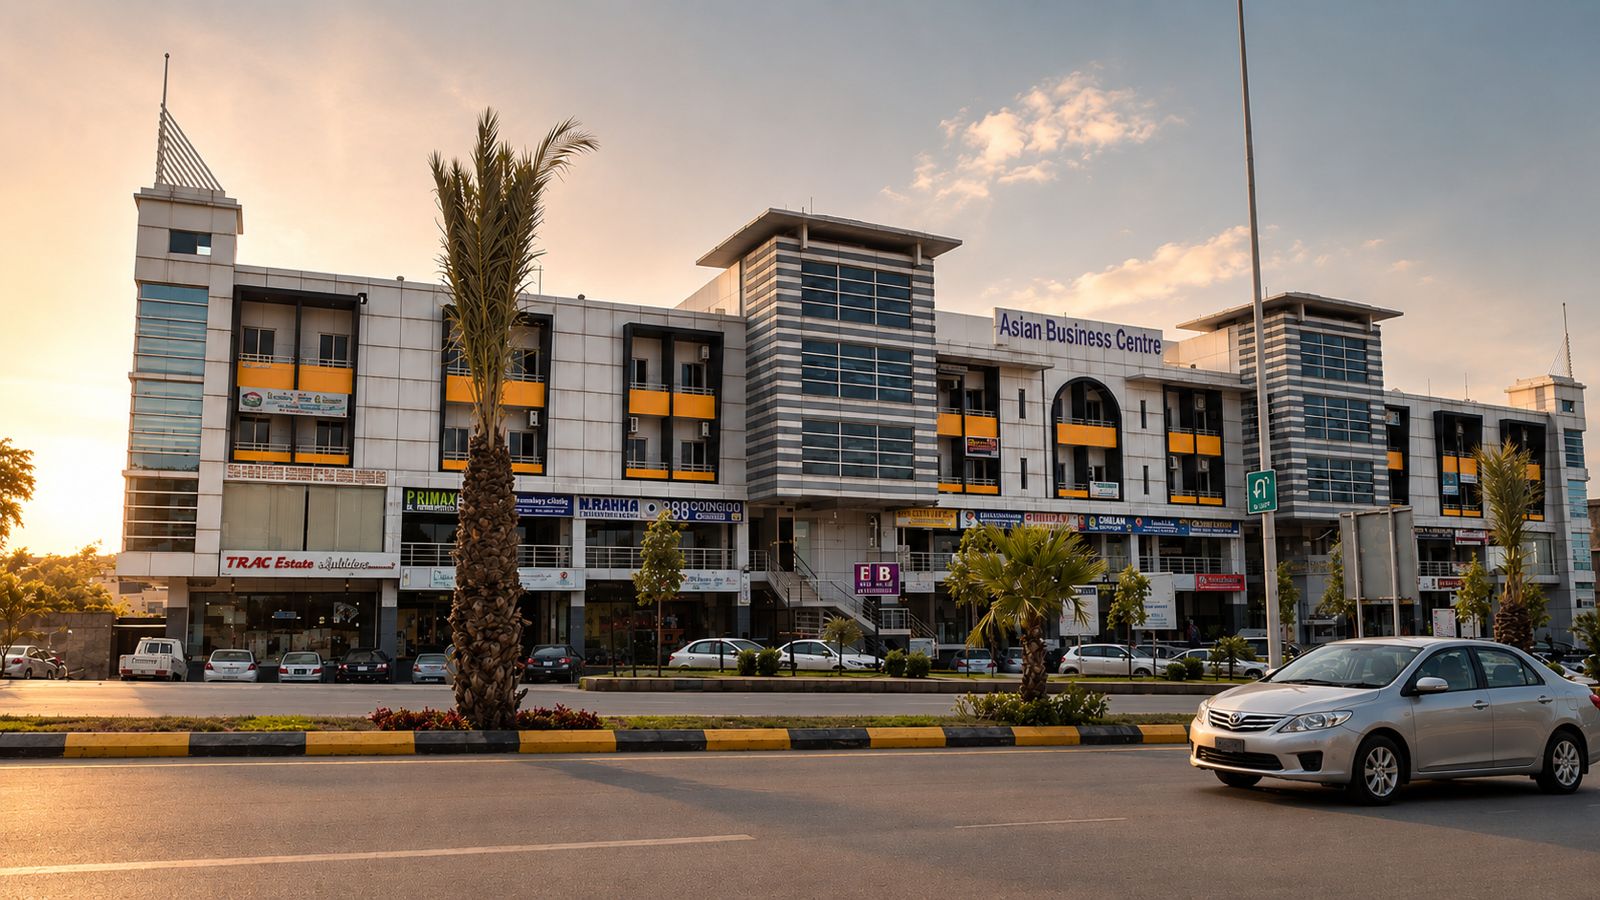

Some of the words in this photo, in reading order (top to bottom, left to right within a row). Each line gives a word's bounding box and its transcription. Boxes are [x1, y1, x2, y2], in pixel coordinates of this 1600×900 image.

[1000, 313, 1042, 340] Asian
[1046, 319, 1112, 349] Business
[1116, 328, 1161, 355] Centre
[406, 490, 456, 505] PRIMAX
[226, 556, 273, 569] TRAC
[274, 556, 314, 569] Estate
[879, 566, 891, 581] B
